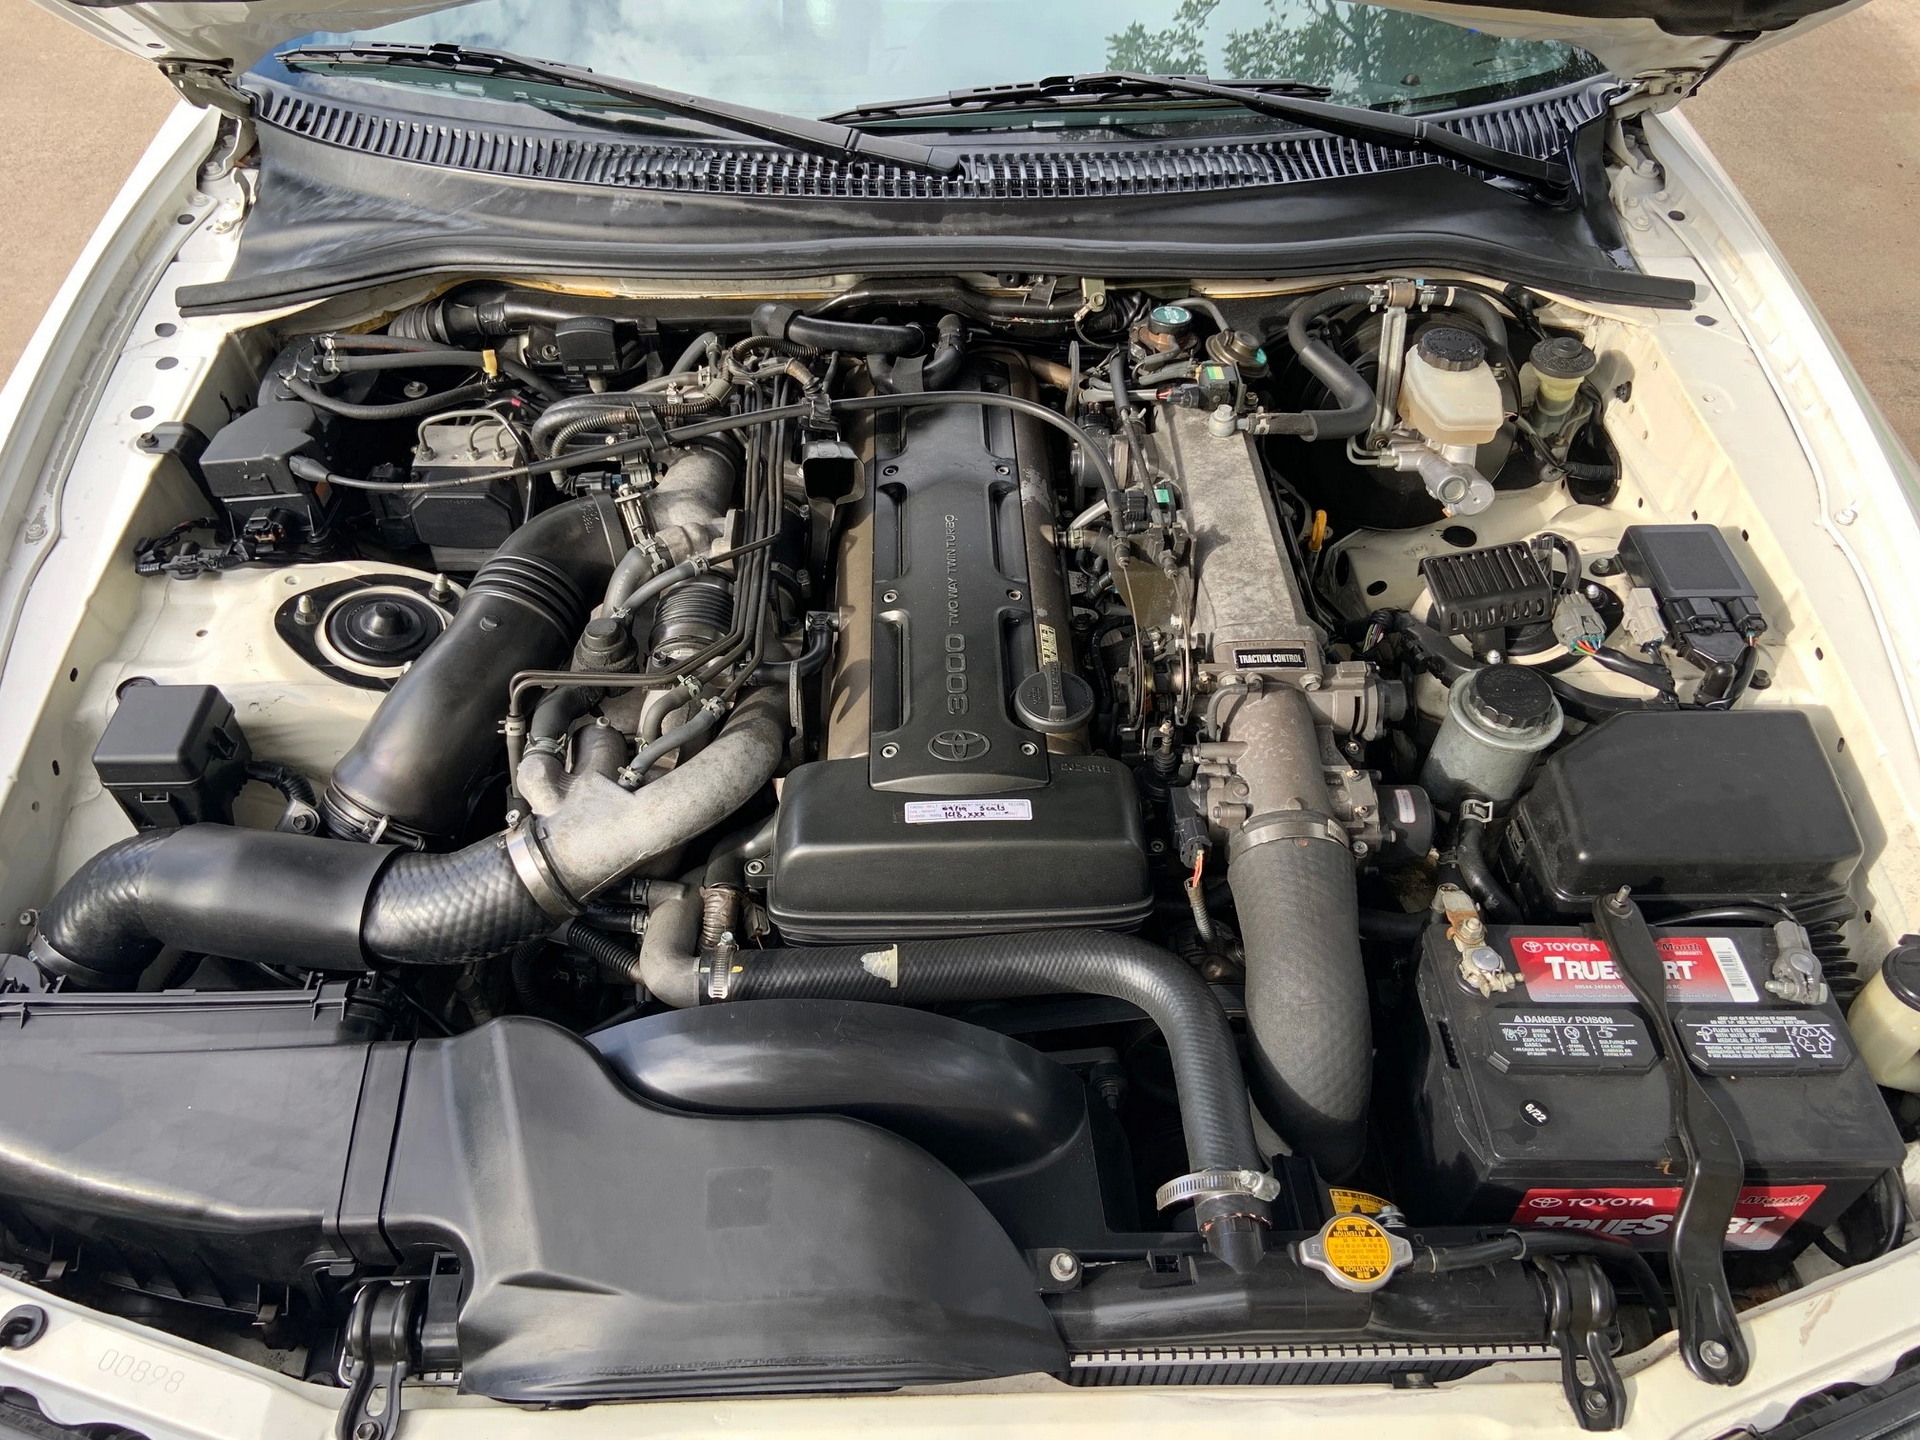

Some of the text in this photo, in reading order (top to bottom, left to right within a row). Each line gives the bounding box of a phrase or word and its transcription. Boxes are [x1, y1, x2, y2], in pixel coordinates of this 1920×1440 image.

[1238, 653, 1303, 664] TRACTION CONTROL
[945, 633, 969, 715] 3000
[1543, 942, 1601, 952] TOYOTA
[1523, 1015, 1566, 1023] DANGER
[1574, 1016, 1613, 1024] POISON
[1525, 1103, 1547, 1123] 6/22
[1568, 1197, 1654, 1207] TOYOTA
[98, 1348, 185, 1393] 00898
